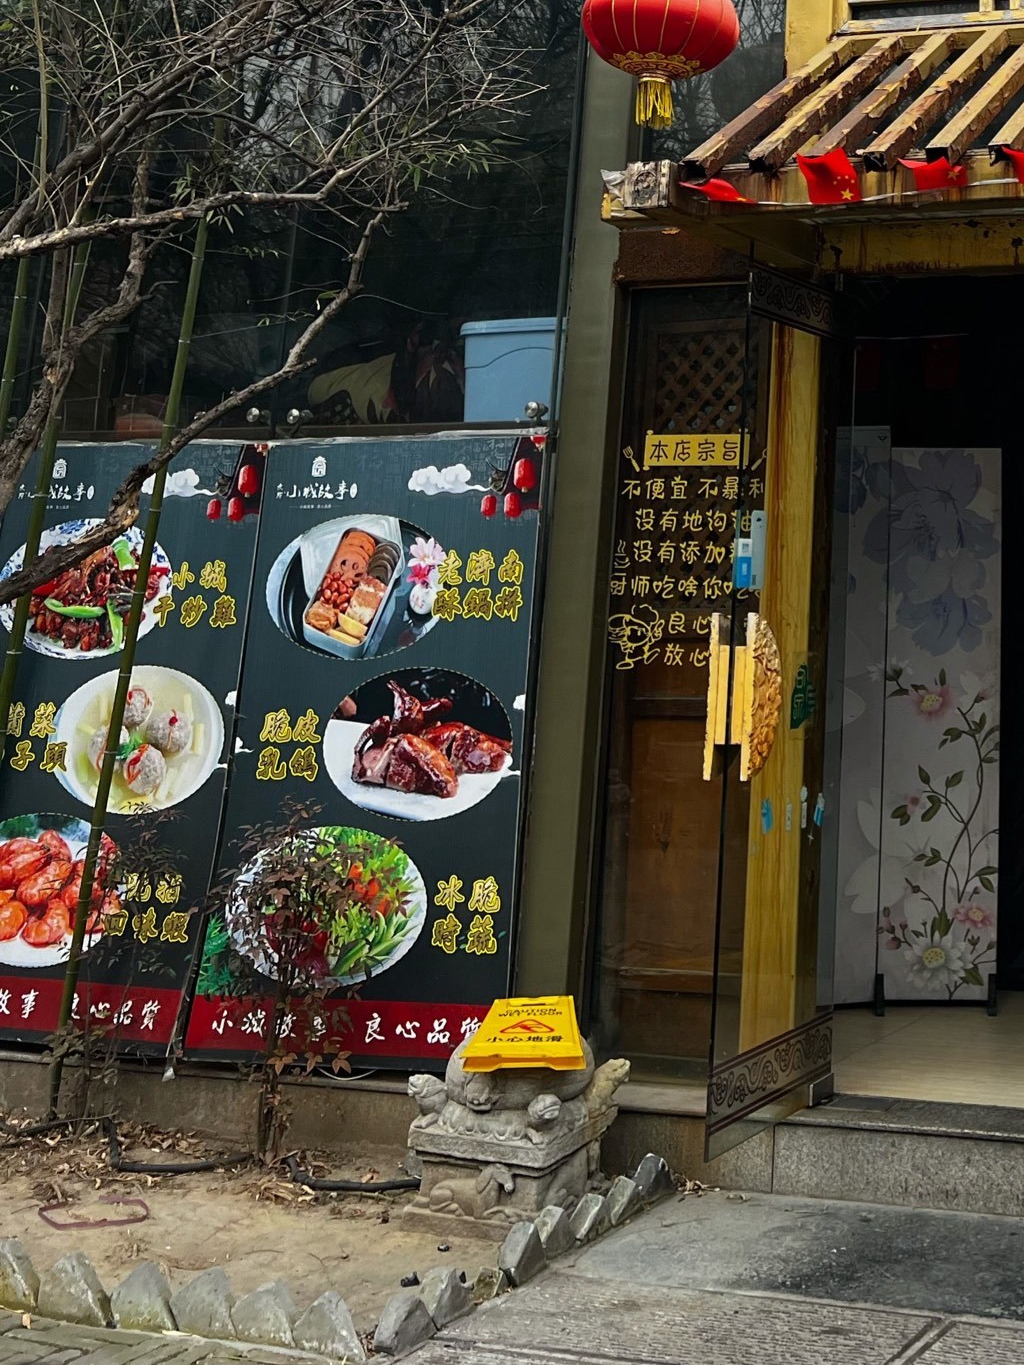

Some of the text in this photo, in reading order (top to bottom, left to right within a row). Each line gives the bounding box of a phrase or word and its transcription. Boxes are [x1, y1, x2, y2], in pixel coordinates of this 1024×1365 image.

[650, 439, 739, 462] 本店宗旨
[286, 480, 349, 500] 小城故事
[621, 475, 688, 499] 不便宜
[635, 508, 751, 532] 没有地沟油
[633, 540, 737, 565] 没有添加
[172, 559, 227, 592] 小城
[259, 708, 321, 743] 脆皮
[0, 740, 68, 773] 子頭
[434, 874, 501, 913] 冰脆
[431, 913, 498, 955] 時蔬
[486, 1035, 563, 1043] 小心地滑
